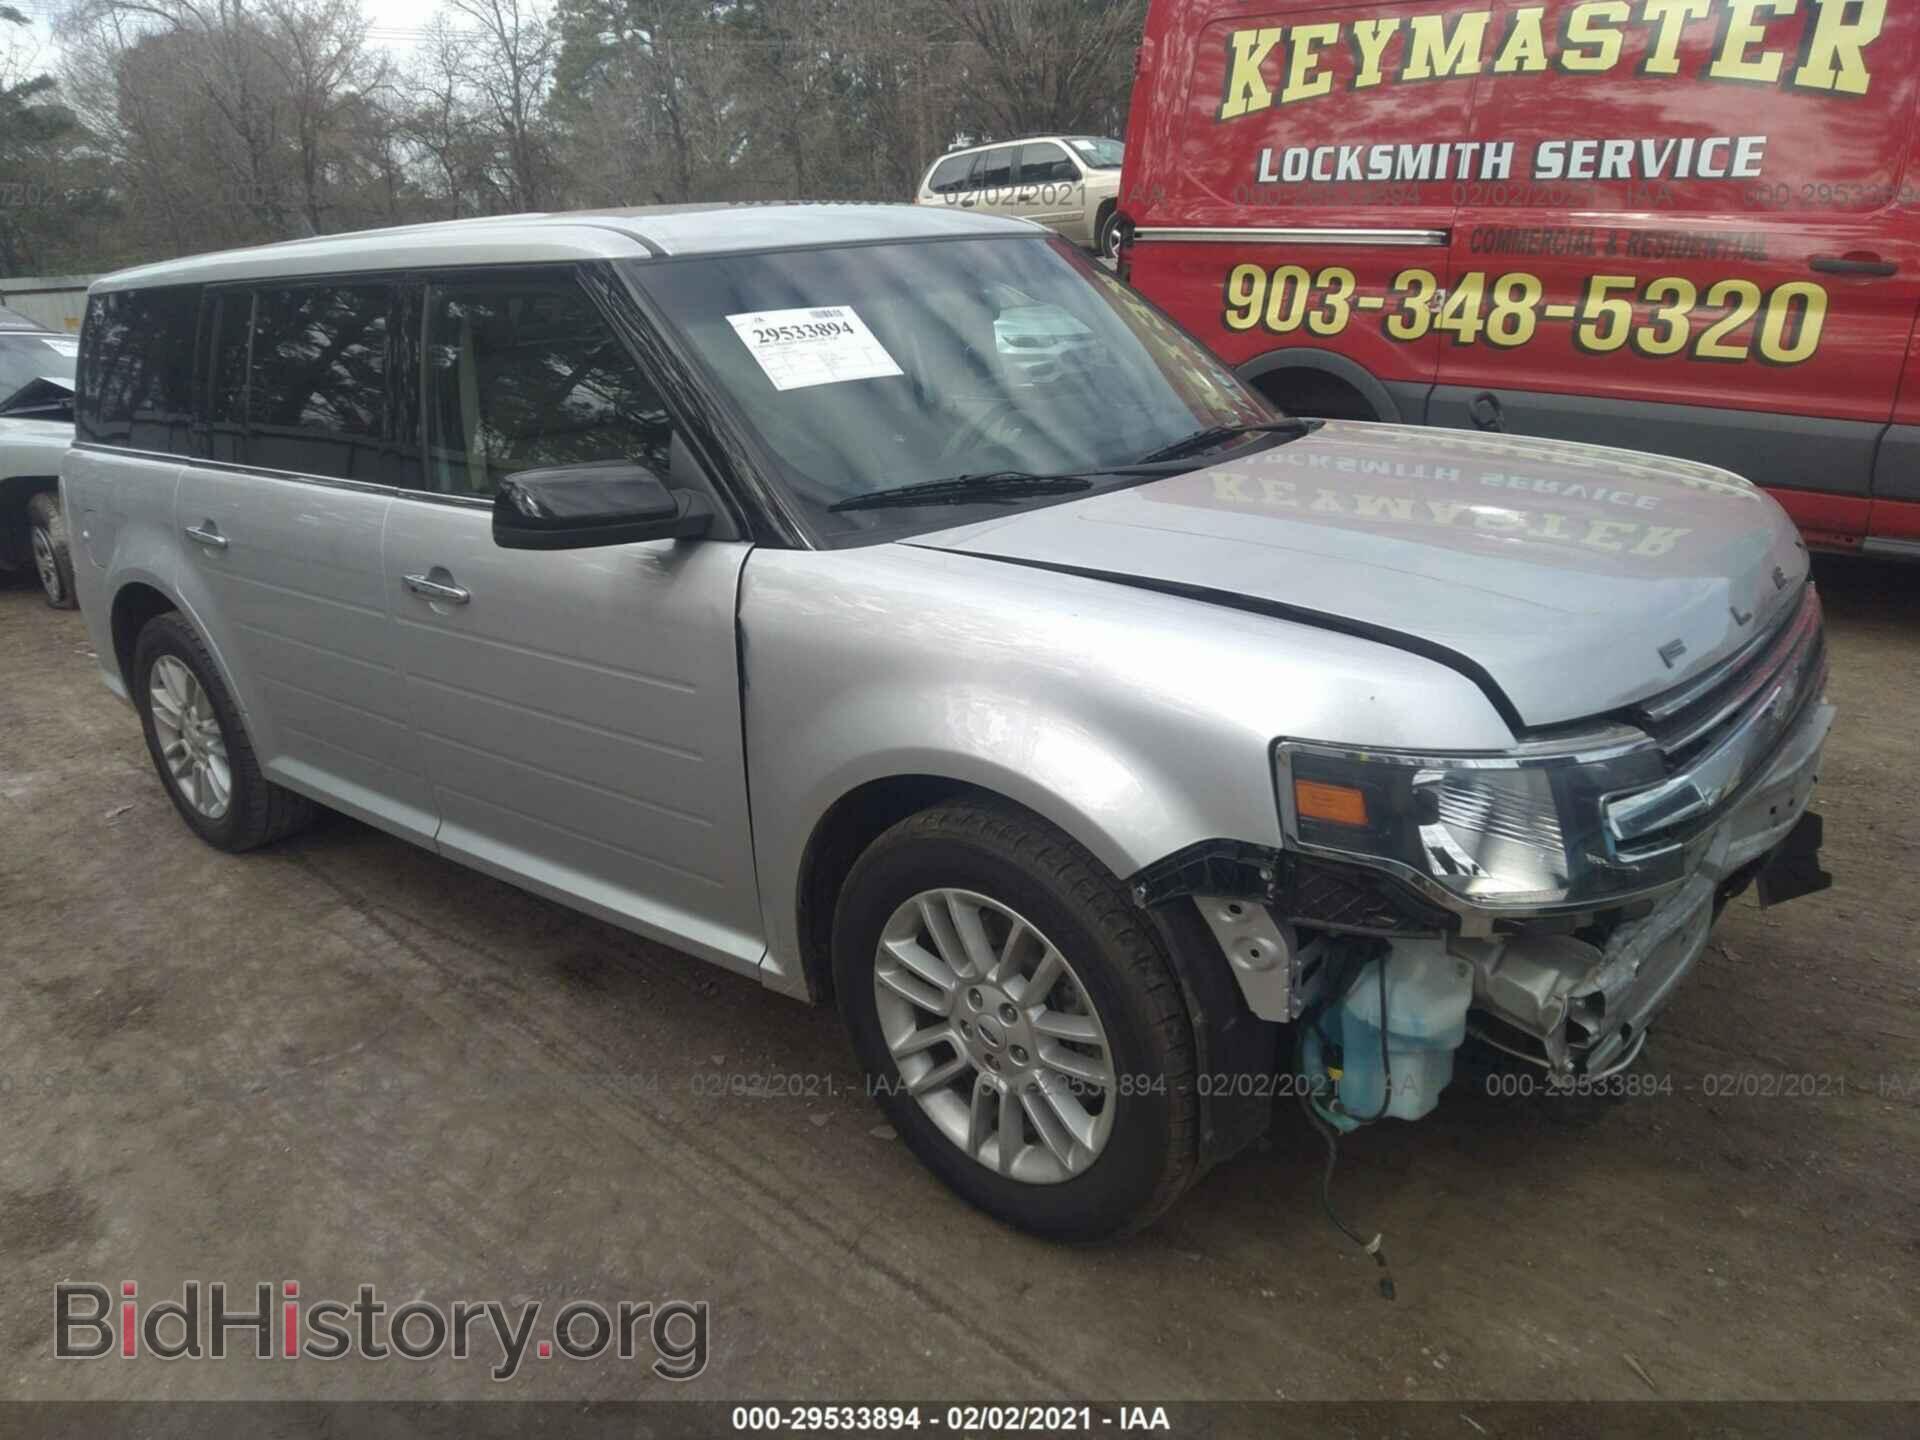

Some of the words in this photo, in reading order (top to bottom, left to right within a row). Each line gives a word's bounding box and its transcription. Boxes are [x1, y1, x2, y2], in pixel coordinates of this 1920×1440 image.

[1219, 0, 1888, 120] KEYMASTER
[1257, 141, 1513, 184] LOCKSMITH
[1535, 136, 1767, 180] SERVICE
[1470, 227, 1597, 256] COMMERCIAL
[1626, 230, 1768, 261] RESIDENTIAL
[753, 320, 854, 343] 29533894
[1222, 262, 1829, 365] 903-348-5320
